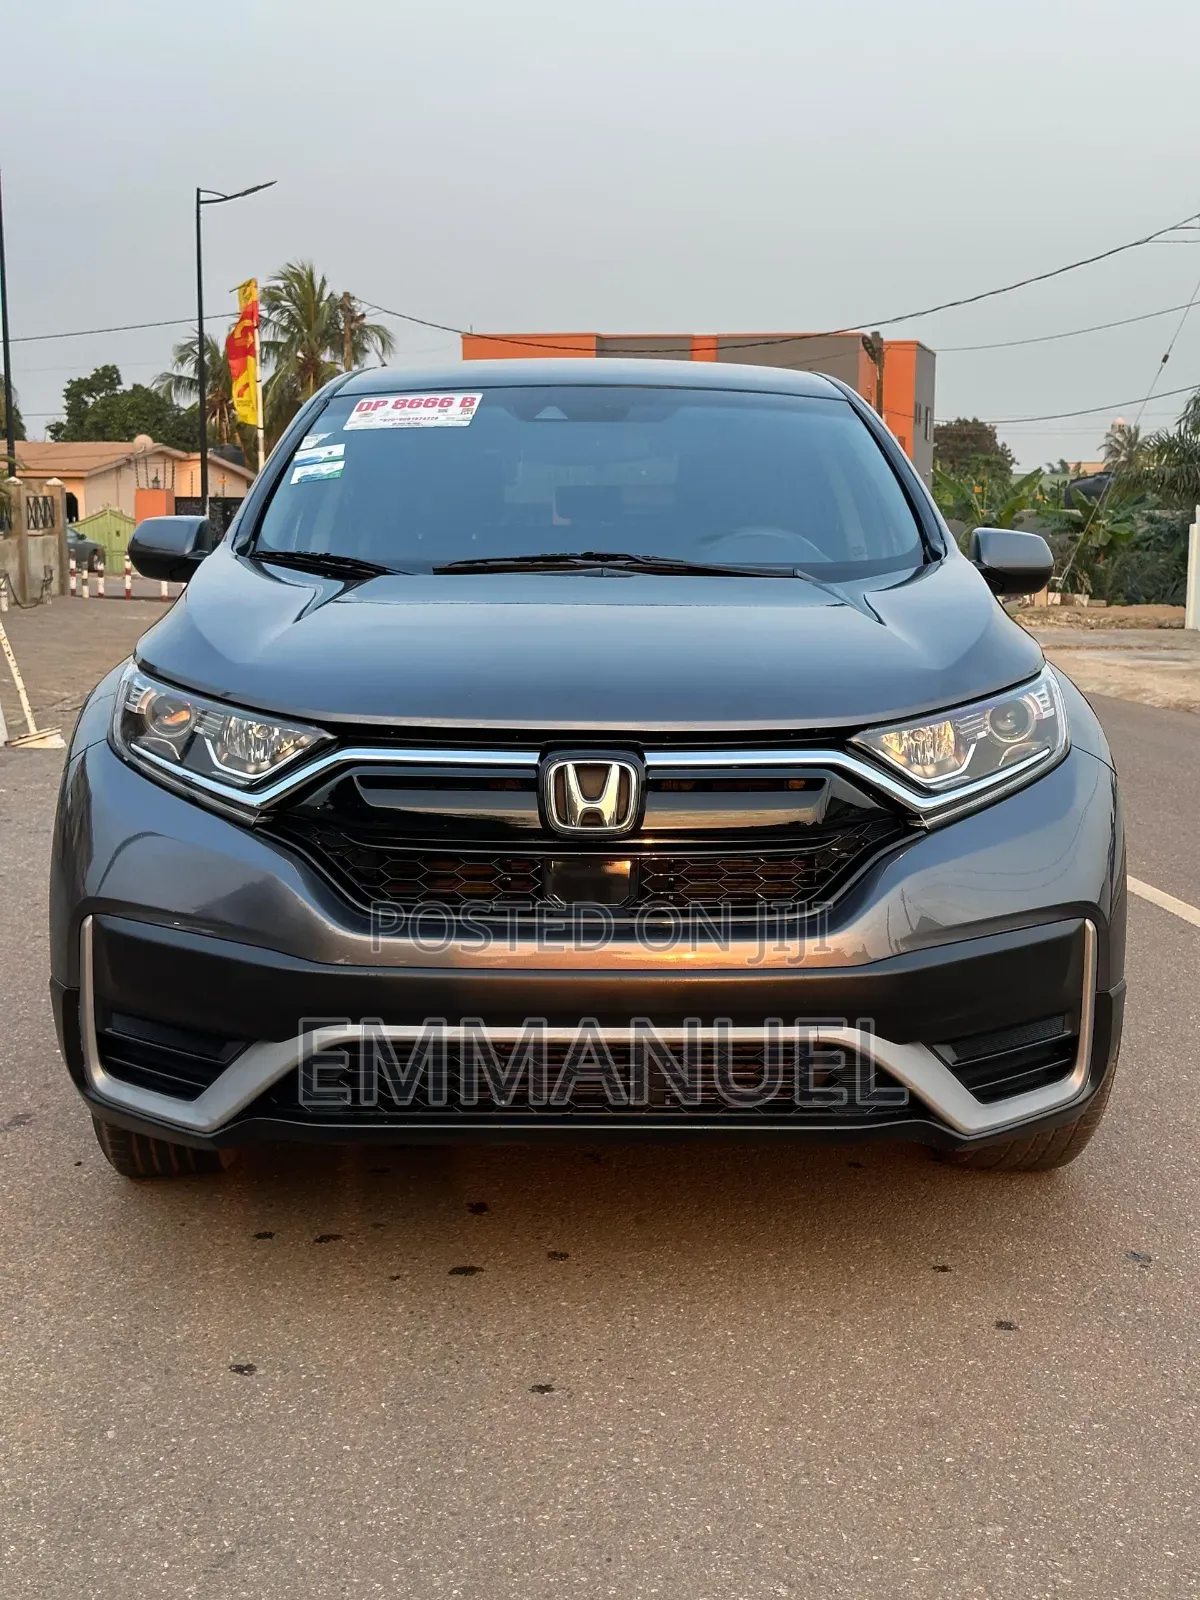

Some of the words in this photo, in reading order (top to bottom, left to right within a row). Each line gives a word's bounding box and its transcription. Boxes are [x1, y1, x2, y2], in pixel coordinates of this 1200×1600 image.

[355, 401, 389, 412] DP
[391, 397, 455, 410] 8666
[459, 396, 476, 408] B
